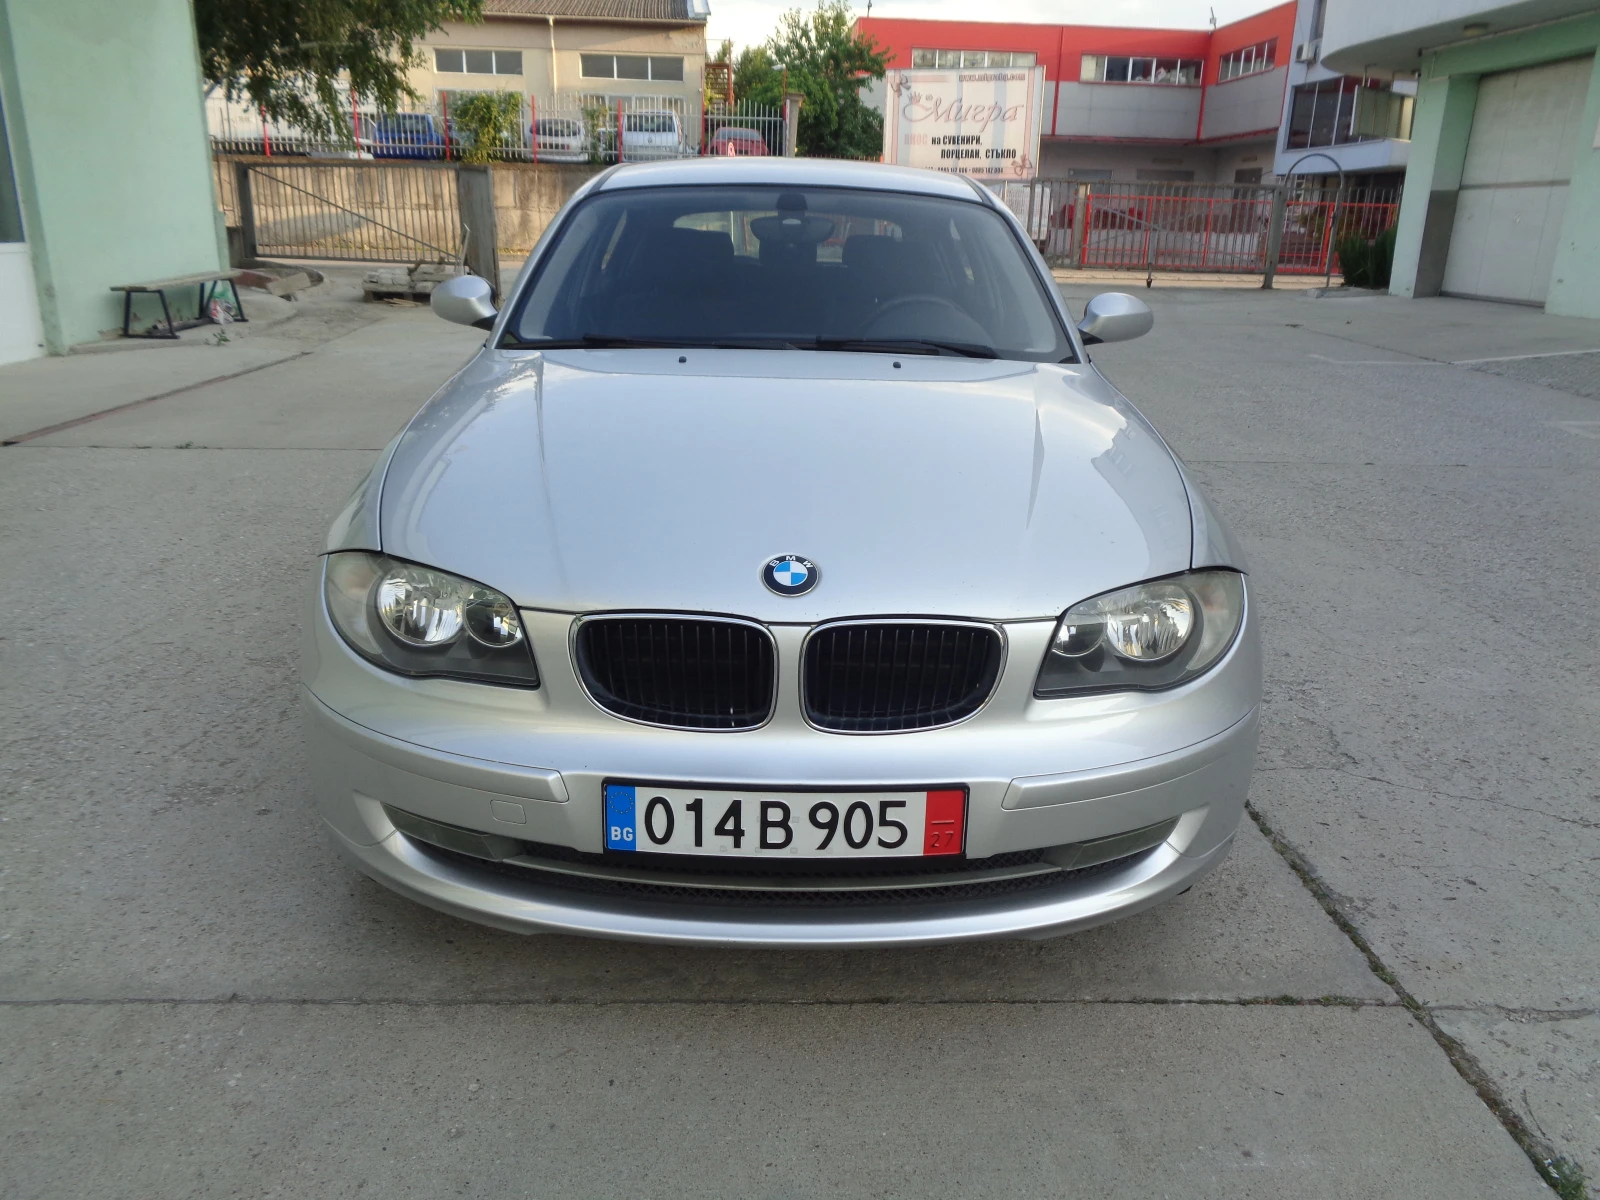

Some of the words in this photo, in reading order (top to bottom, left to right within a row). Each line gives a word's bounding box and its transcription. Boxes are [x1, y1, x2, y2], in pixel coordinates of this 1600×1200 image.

[931, 136, 941, 145] на
[943, 135, 983, 146] СУВЕНИРИ,
[940, 149, 982, 160] ПОРЦЕЛАН,
[769, 555, 814, 568] BMW
[611, 826, 634, 842] BG
[930, 830, 955, 848] 27
